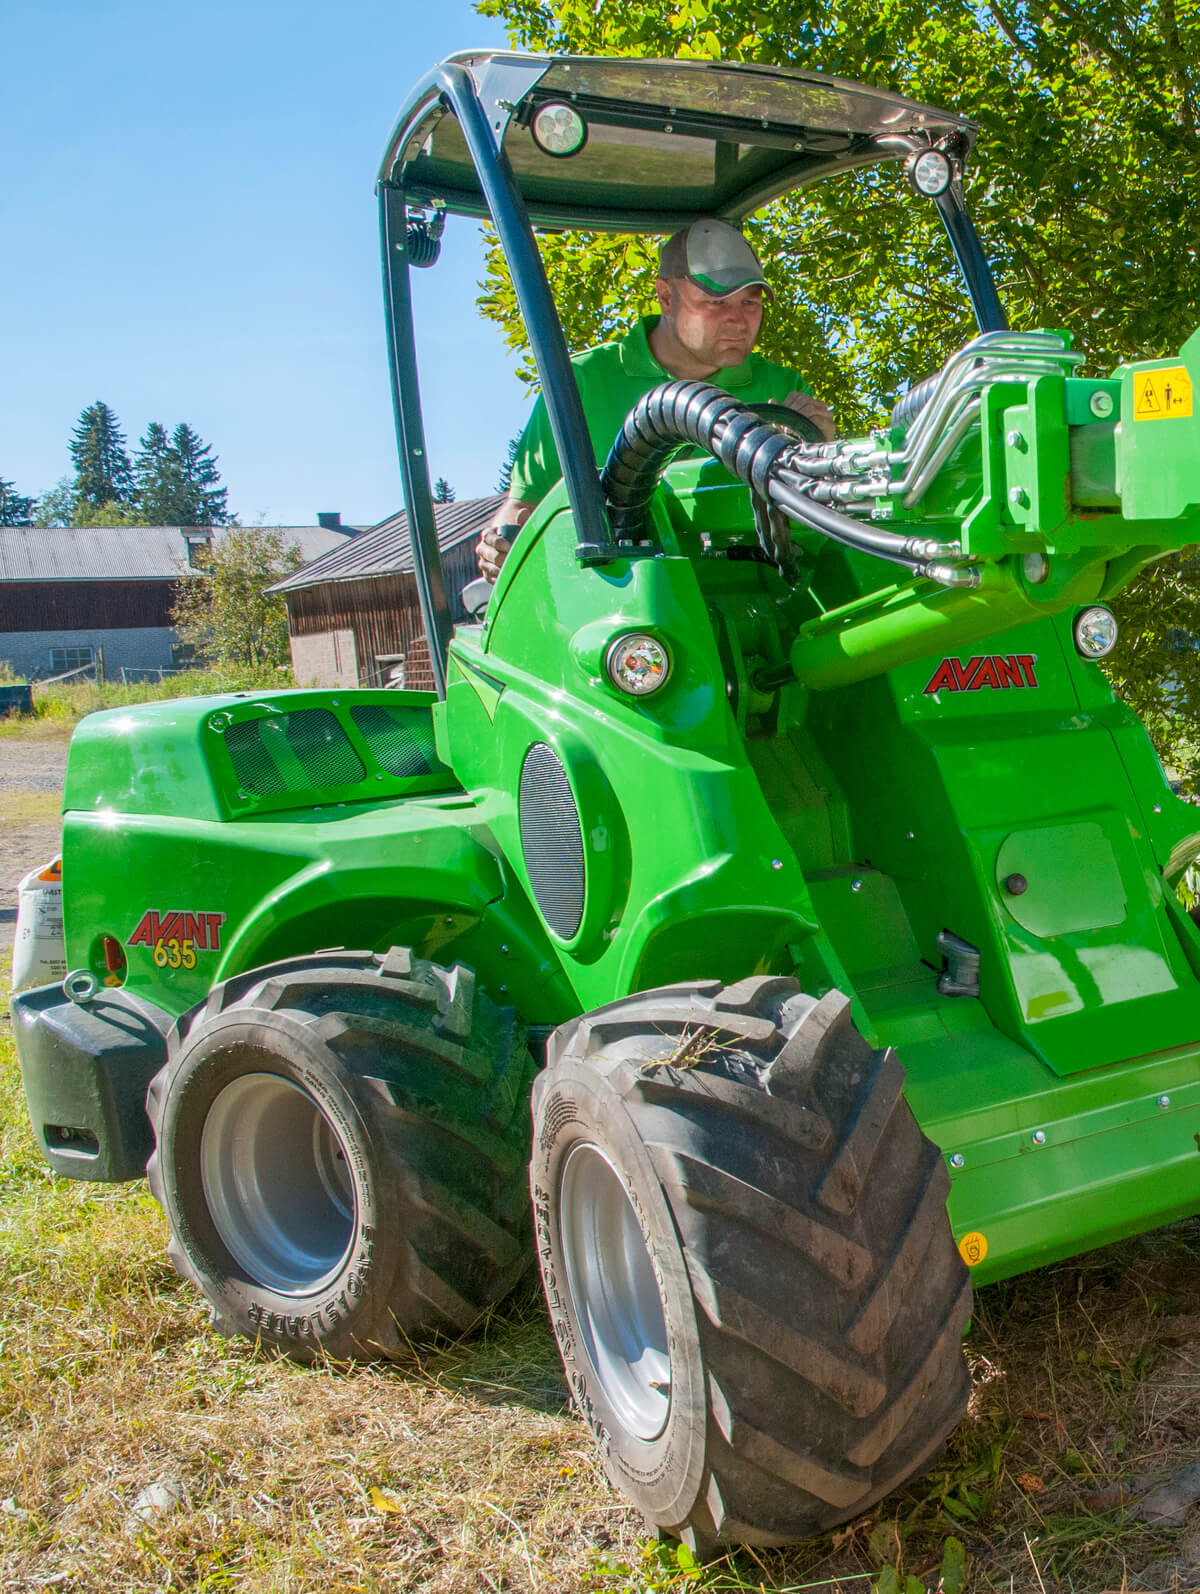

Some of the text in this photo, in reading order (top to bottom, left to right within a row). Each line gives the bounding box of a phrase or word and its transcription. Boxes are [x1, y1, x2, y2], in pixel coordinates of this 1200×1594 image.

[922, 654, 1039, 694] AVANT
[126, 910, 222, 951] AVANT
[153, 937, 197, 969] 635
[535, 1184, 562, 1309] LOADER
[248, 1302, 328, 1337] LOADER
